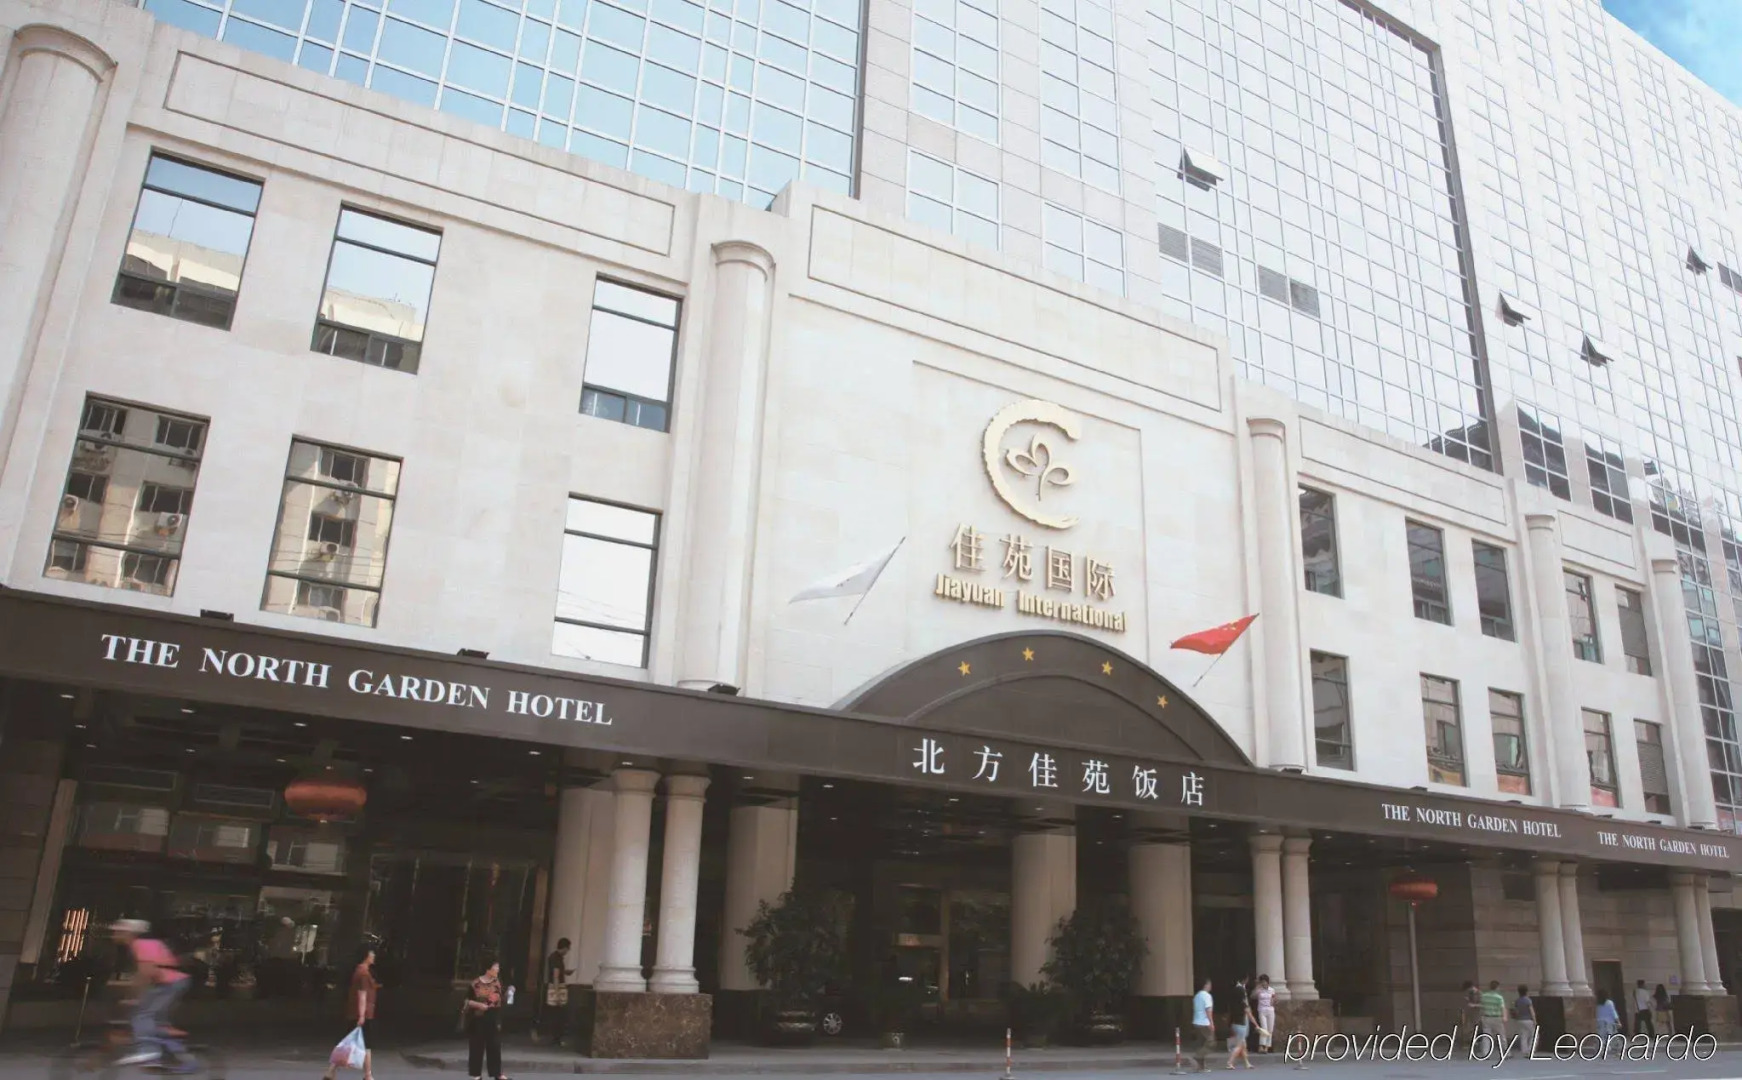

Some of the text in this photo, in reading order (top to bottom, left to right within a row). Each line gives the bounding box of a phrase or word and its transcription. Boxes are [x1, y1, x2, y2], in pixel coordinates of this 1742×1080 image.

[949, 523, 1117, 600] 佳苑国际
[934, 572, 1127, 633] Jiayuan International
[101, 633, 613, 726] THE NORTH GARDEN HOTEL
[912, 738, 1205, 806] 北方佳苑饭店
[1381, 803, 1562, 838] THE NORTH GARDEN HOTEL
[1597, 831, 1730, 859] THE NORTH GARDEN HOTEL
